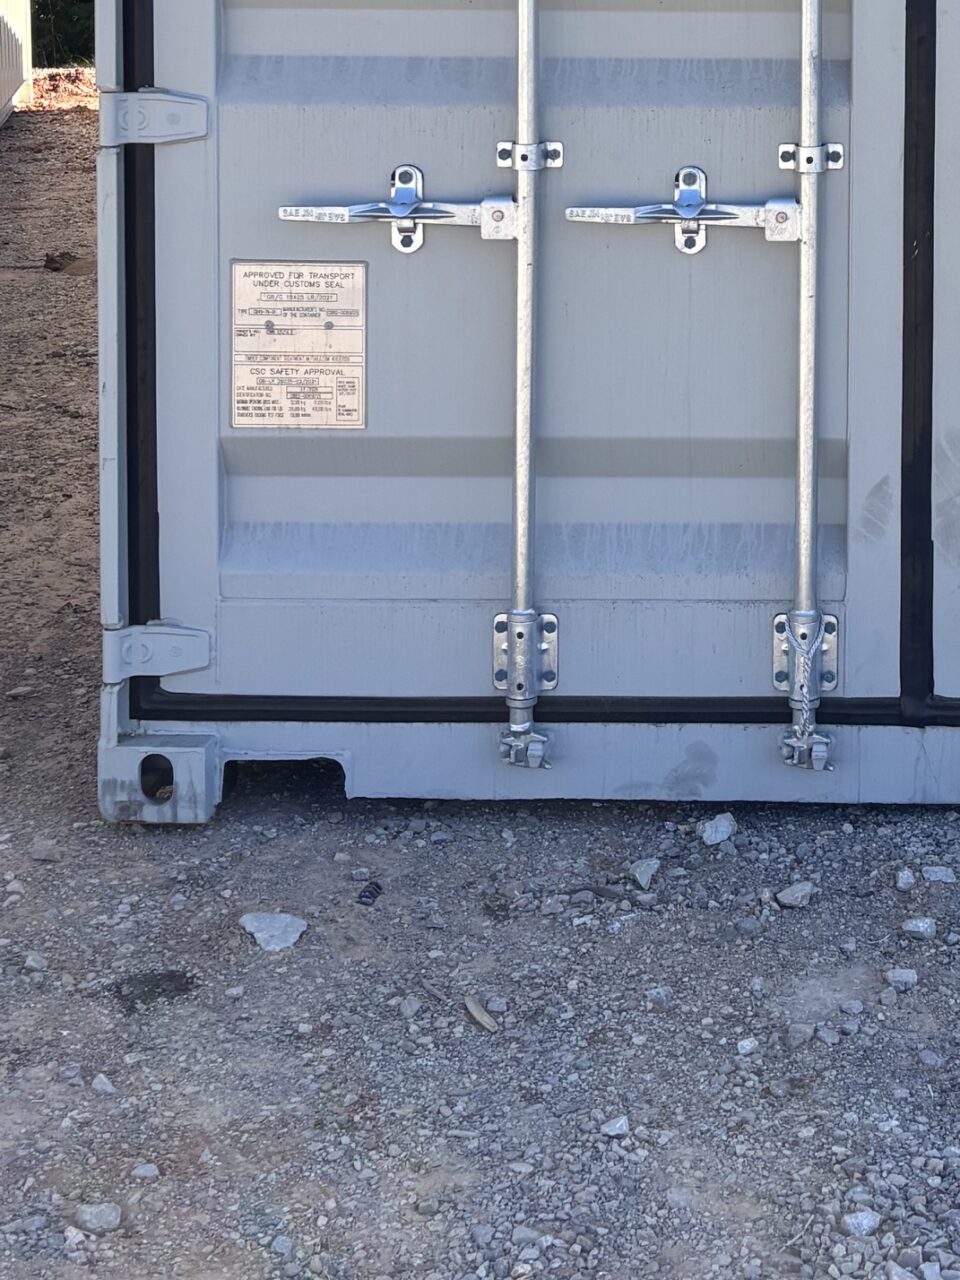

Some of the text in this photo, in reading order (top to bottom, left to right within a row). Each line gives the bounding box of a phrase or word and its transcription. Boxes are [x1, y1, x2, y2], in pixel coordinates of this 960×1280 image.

[243, 271, 355, 280] APPROVED FOR TRANSPORT
[284, 280, 321, 288] CUSTOMS
[250, 368, 345, 376] CSC SAFETY APPROVAL
